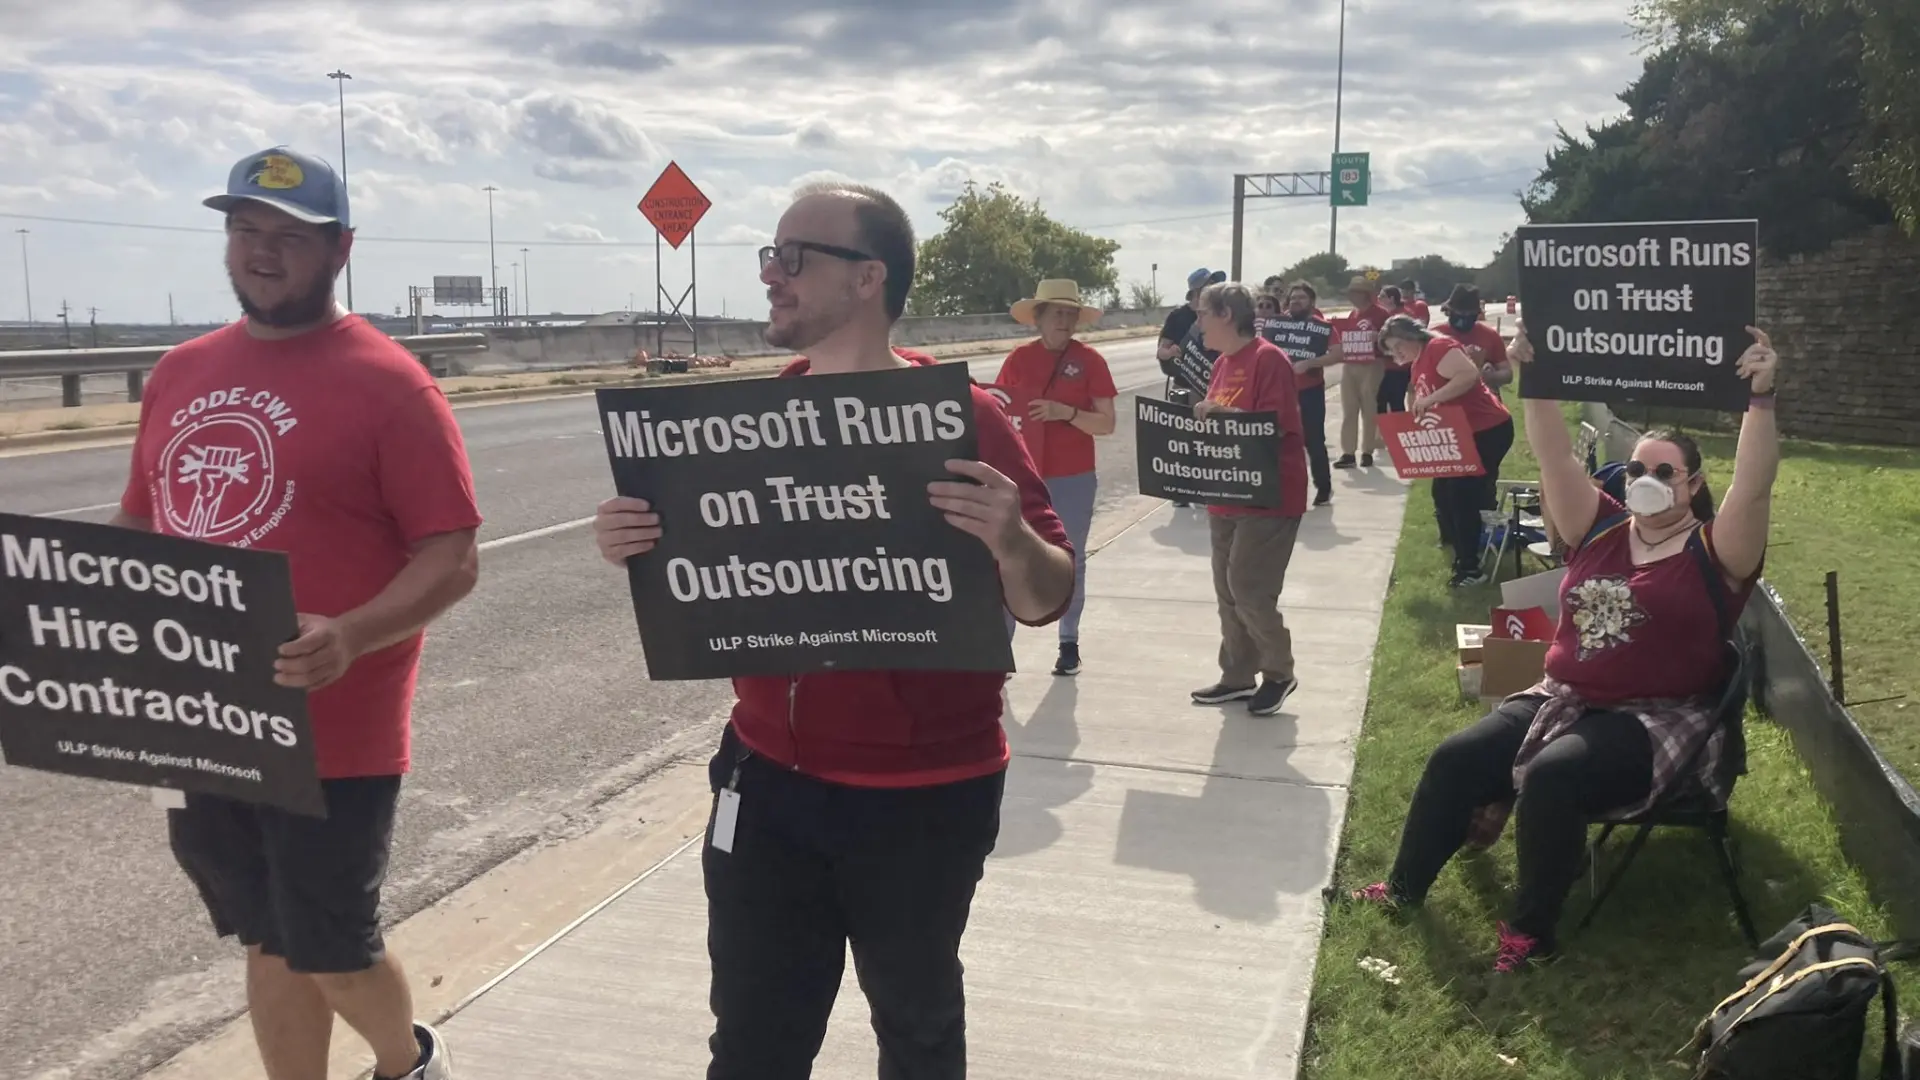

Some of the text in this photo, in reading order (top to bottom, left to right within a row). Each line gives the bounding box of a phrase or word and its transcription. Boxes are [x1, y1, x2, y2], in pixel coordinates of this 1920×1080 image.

[1336, 156, 1366, 165] SOUTH
[1341, 171, 1358, 181] 183
[646, 196, 703, 209] CONSTRUCTION
[655, 209, 692, 220] ENTRANCE
[663, 222, 688, 232] AHEAD
[1523, 237, 1750, 267] Microsoft Runs
[1574, 283, 1693, 312] on Trust
[1265, 319, 1330, 336] Microsoft Runs
[1274, 333, 1286, 341] on
[1288, 333, 1311, 345] Trust
[1546, 325, 1723, 365] Outsourcing
[1562, 375, 1704, 391] ULP Strike Against Microsoft
[170, 387, 298, 437] CODE-CWA
[1139, 403, 1275, 436] Microsoft Runs
[607, 396, 966, 458] Microsoft Runs
[1397, 428, 1458, 447] REMOTE
[1168, 439, 1241, 460] on Trust
[1405, 445, 1462, 463] WORKS
[1152, 457, 1262, 486] Outsourcing
[1402, 467, 1418, 475] RTO
[250, 480, 295, 540] Employees
[700, 474, 892, 528] on Trust
[1, 533, 246, 612] Microsoft
[666, 547, 953, 603] Outsourcing
[27, 604, 240, 673] Hire Our
[709, 628, 938, 652] ULP Strike Against Microsoft
[0, 664, 297, 747] Contractors
[57, 740, 263, 782] ULP Strike Against Microsoft
